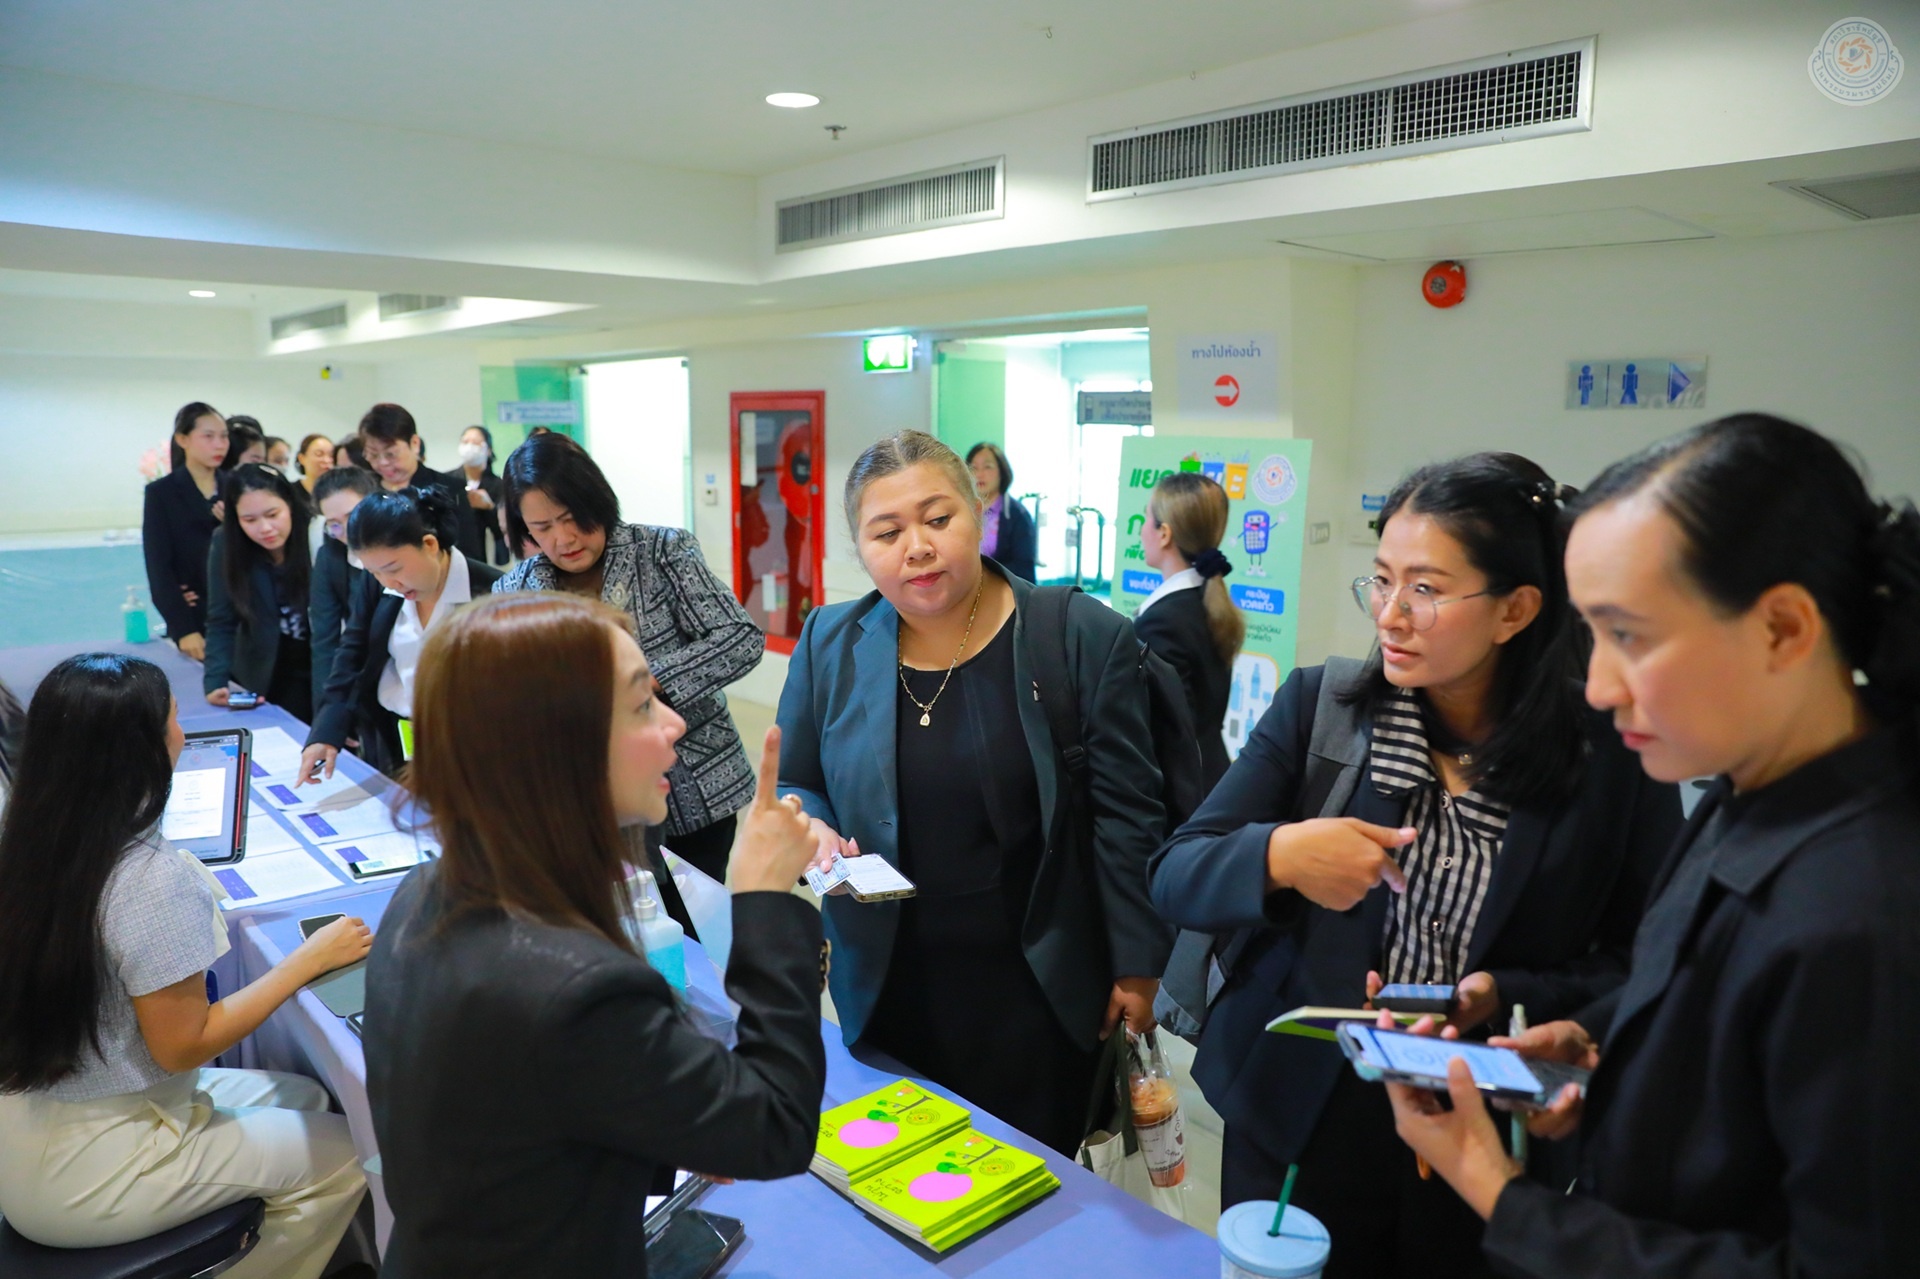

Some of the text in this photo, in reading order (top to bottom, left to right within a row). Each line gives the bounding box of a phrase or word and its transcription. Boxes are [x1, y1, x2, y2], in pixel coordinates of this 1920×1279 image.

[1191, 339, 1261, 359] ทางไปห้องน้ำ
